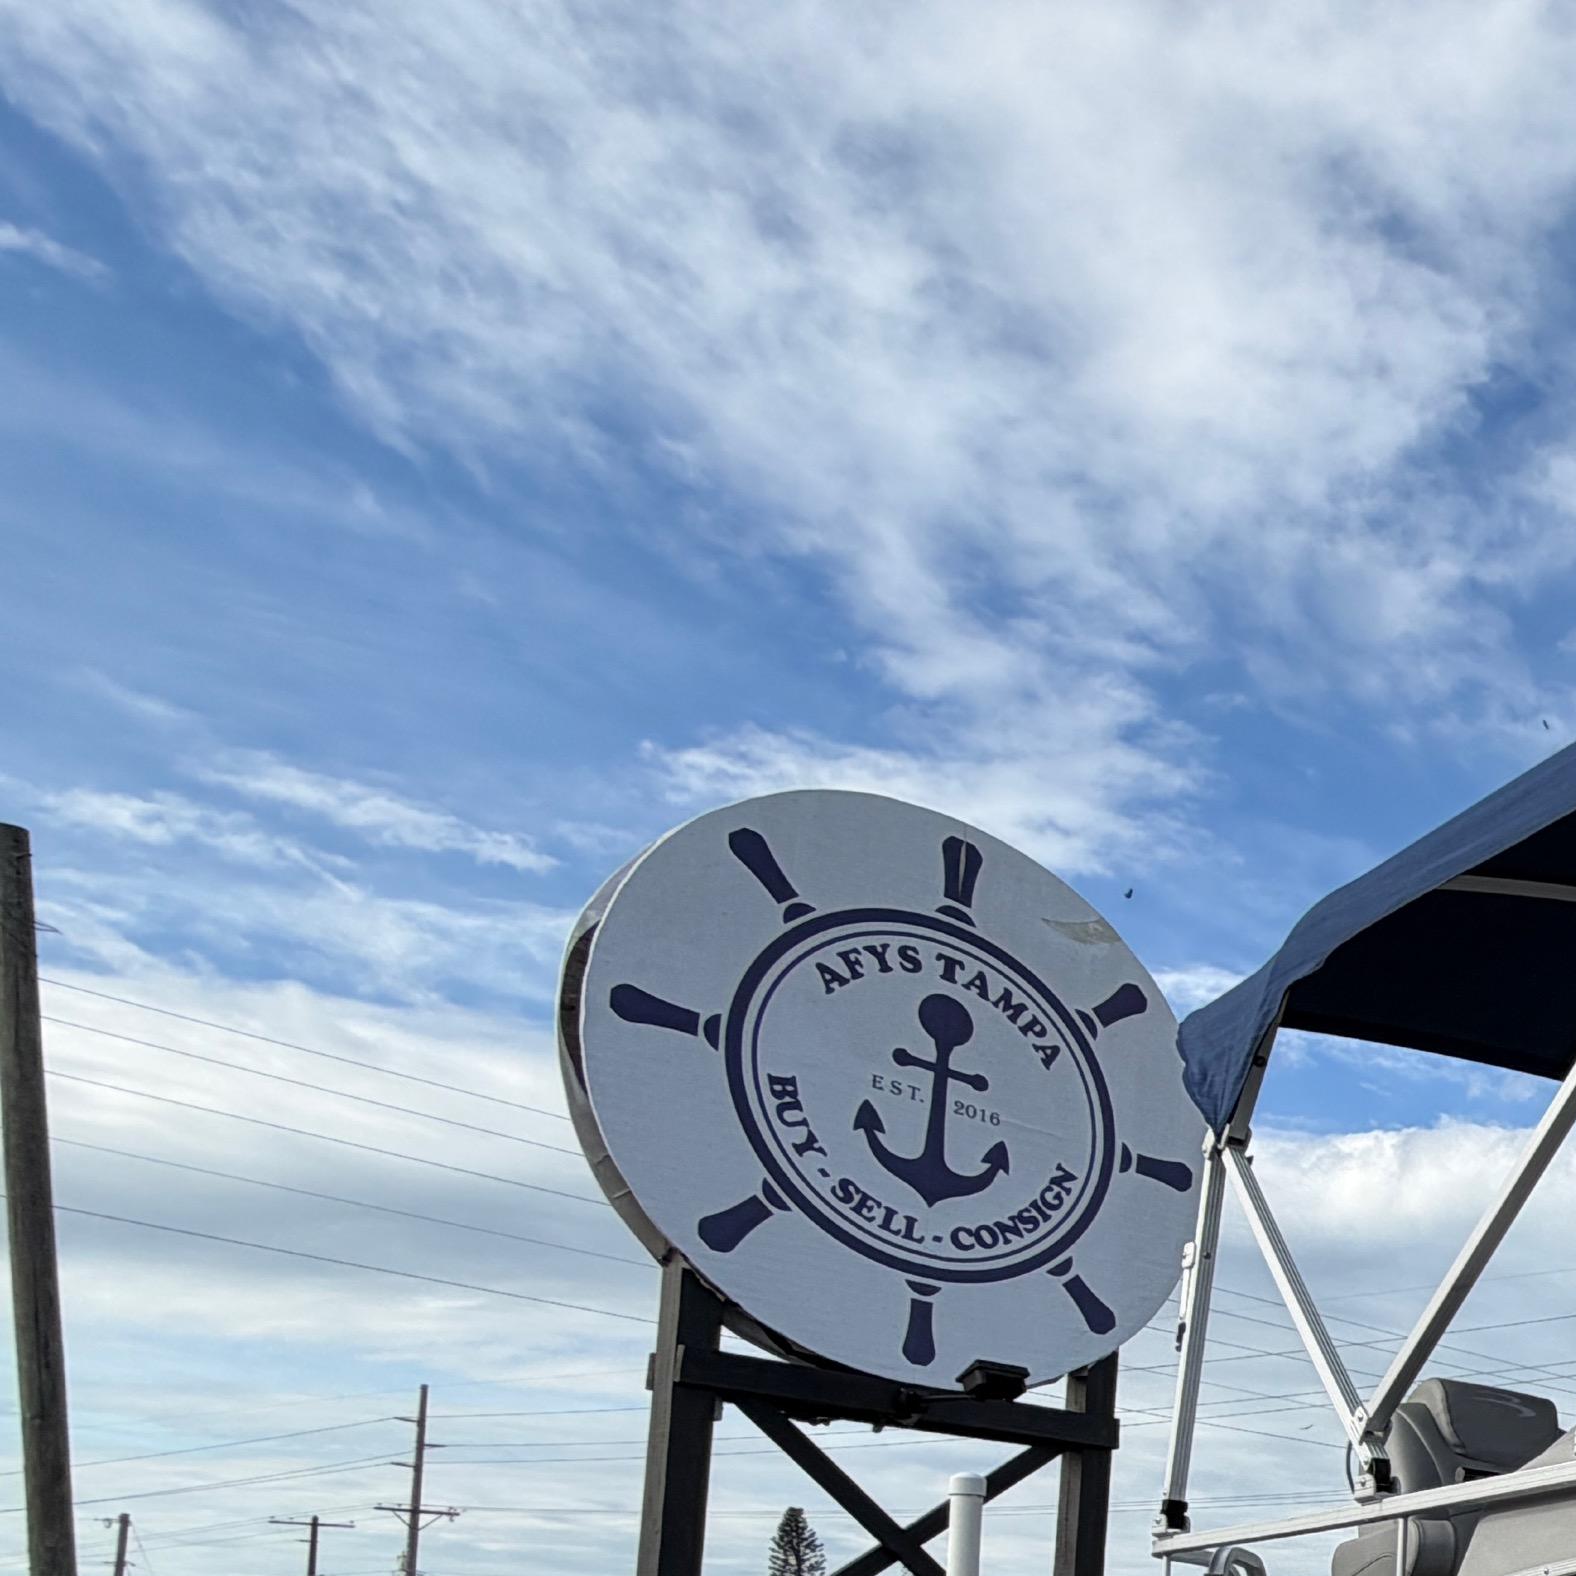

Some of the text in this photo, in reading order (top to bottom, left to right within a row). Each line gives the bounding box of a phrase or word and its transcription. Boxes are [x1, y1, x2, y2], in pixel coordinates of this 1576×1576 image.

[815, 944, 1061, 1070] AFYS TAMPA
[767, 1073, 828, 1157] BUY
[831, 1178, 925, 1244] SELL
[950, 1163, 1079, 1252] CONSIGN
[871, 1074, 1001, 1126] EST. 2016
